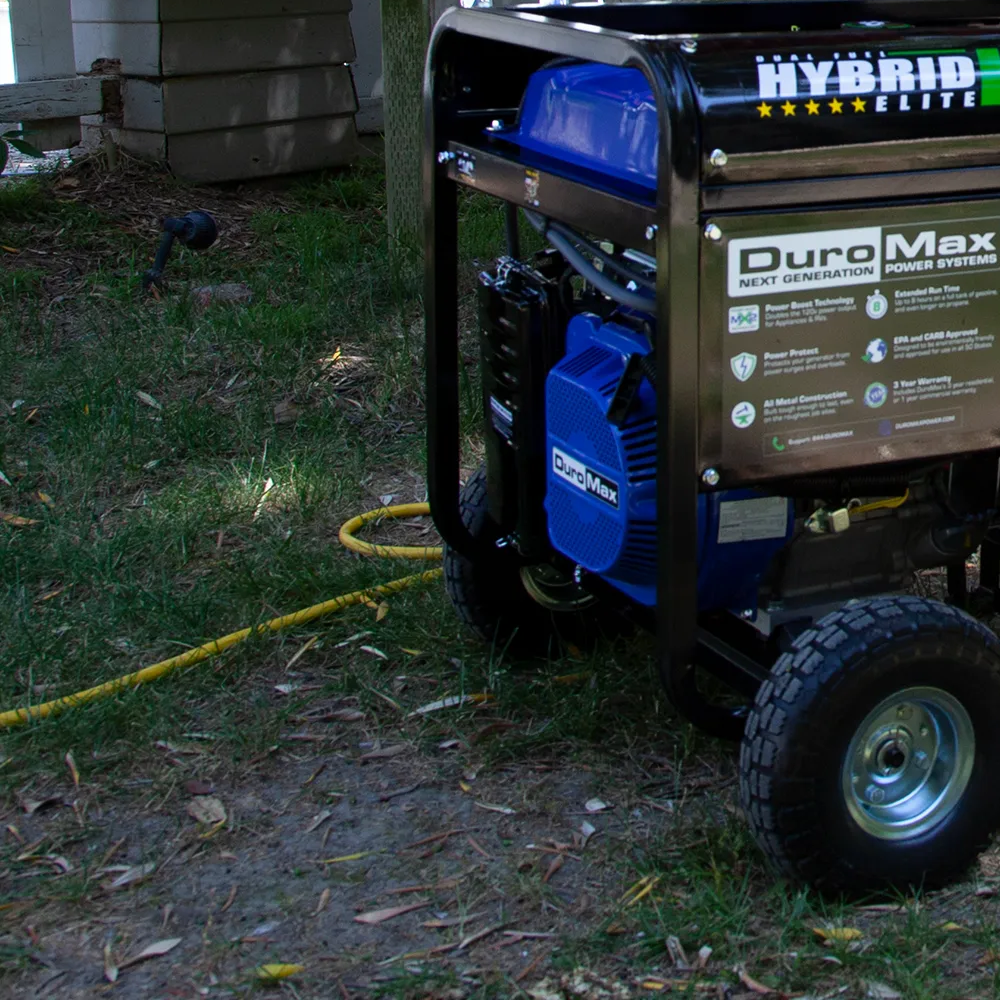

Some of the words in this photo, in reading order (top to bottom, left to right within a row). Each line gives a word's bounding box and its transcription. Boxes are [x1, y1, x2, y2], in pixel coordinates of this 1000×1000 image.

[757, 54, 977, 99] HYBRID
[875, 90, 977, 112] ELITE
[738, 275, 778, 289] NEXT
[782, 265, 875, 284] GENERATION
[884, 259, 933, 274] POWER
[936, 252, 998, 269] SYSTEMS
[894, 287, 928, 298] Extended
[928, 286, 943, 294] Run
[943, 285, 960, 293] Time
[765, 303, 790, 312] Power
[814, 296, 855, 307] Technology
[893, 335, 909, 344] EPA
[909, 334, 923, 342] and
[945, 327, 979, 339] Approved
[764, 351, 789, 360] Power
[789, 347, 820, 358] Protect
[899, 379, 917, 388] Year
[917, 375, 952, 386] Warranty
[764, 398, 775, 408] All
[775, 396, 799, 406] Metal
[799, 390, 848, 404] Construction
